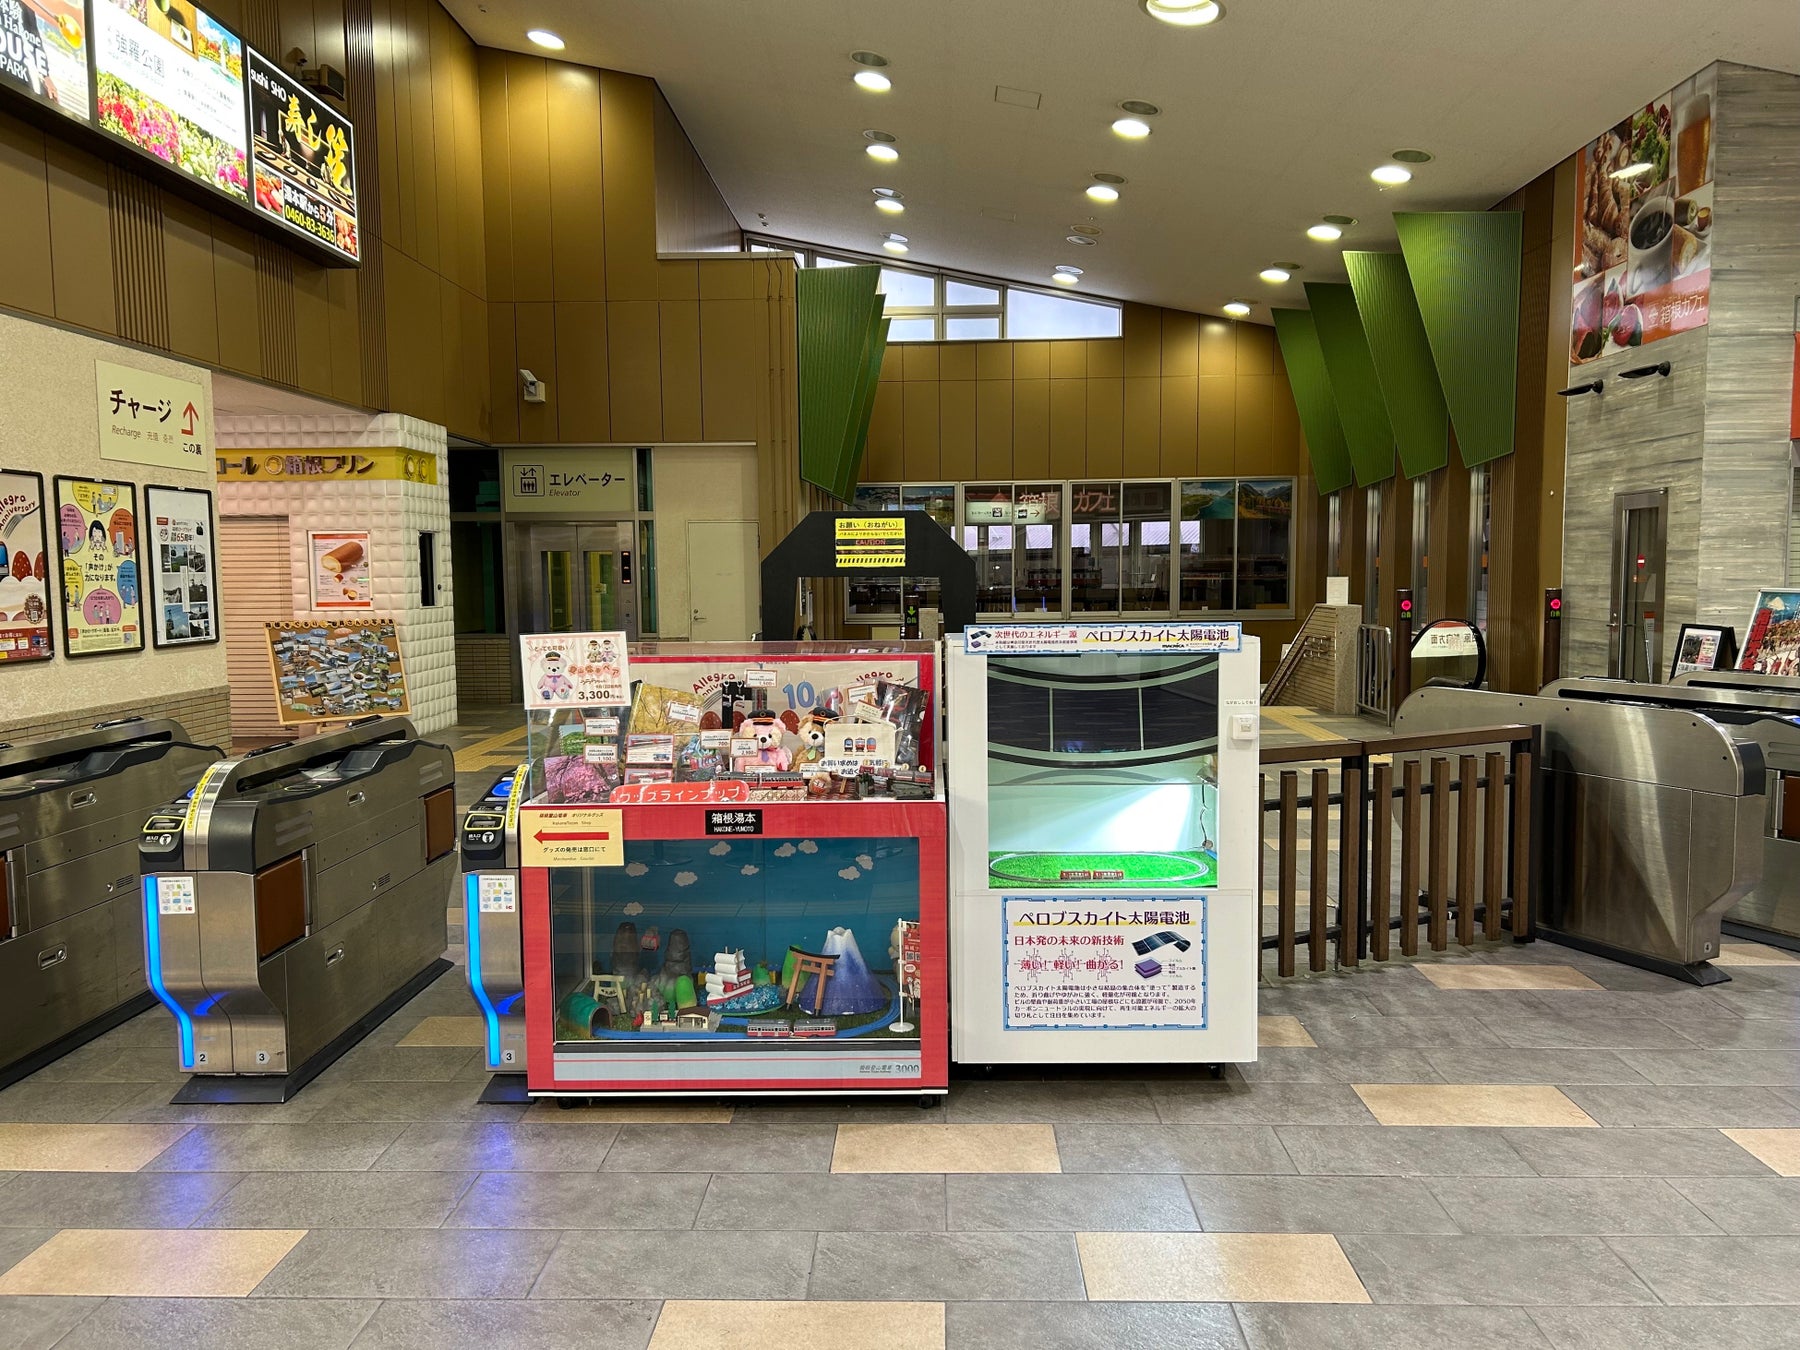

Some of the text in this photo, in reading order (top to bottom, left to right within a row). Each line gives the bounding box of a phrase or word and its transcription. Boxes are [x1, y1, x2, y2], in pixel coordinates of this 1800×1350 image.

[115, 30, 165, 78] 強羅公園
[250, 69, 287, 103] sushi SHO
[285, 204, 335, 243] 0460-83-3636
[1660, 295, 1705, 325] 箱根カフェ
[109, 389, 172, 423] チャージ
[111, 424, 141, 440] Recharge
[183, 442, 203, 456] この裏
[285, 455, 375, 475] 箱根プリン
[549, 472, 626, 487] エレベーター
[549, 488, 581, 497] Elevator
[1073, 491, 1116, 514] カフェ
[93, 553, 104, 561] その
[85, 563, 113, 572] 「声かけ」が
[84, 573, 117, 583] 力になります。
[995, 630, 1078, 639] 次世代のエネルギー源
[1085, 629, 1230, 642] ペロブスカイト太陽電池
[693, 673, 736, 694] Allegro
[711, 812, 756, 824] 箱根湯本
[1019, 910, 1190, 926] ペロブスカイト太陽電池
[1014, 935, 1125, 946] 日本発の未来の新技術
[200, 1053, 205, 1062] 2
[258, 1053, 265, 1062] 3
[506, 1052, 512, 1061] 3
[895, 1064, 919, 1073] 3000
